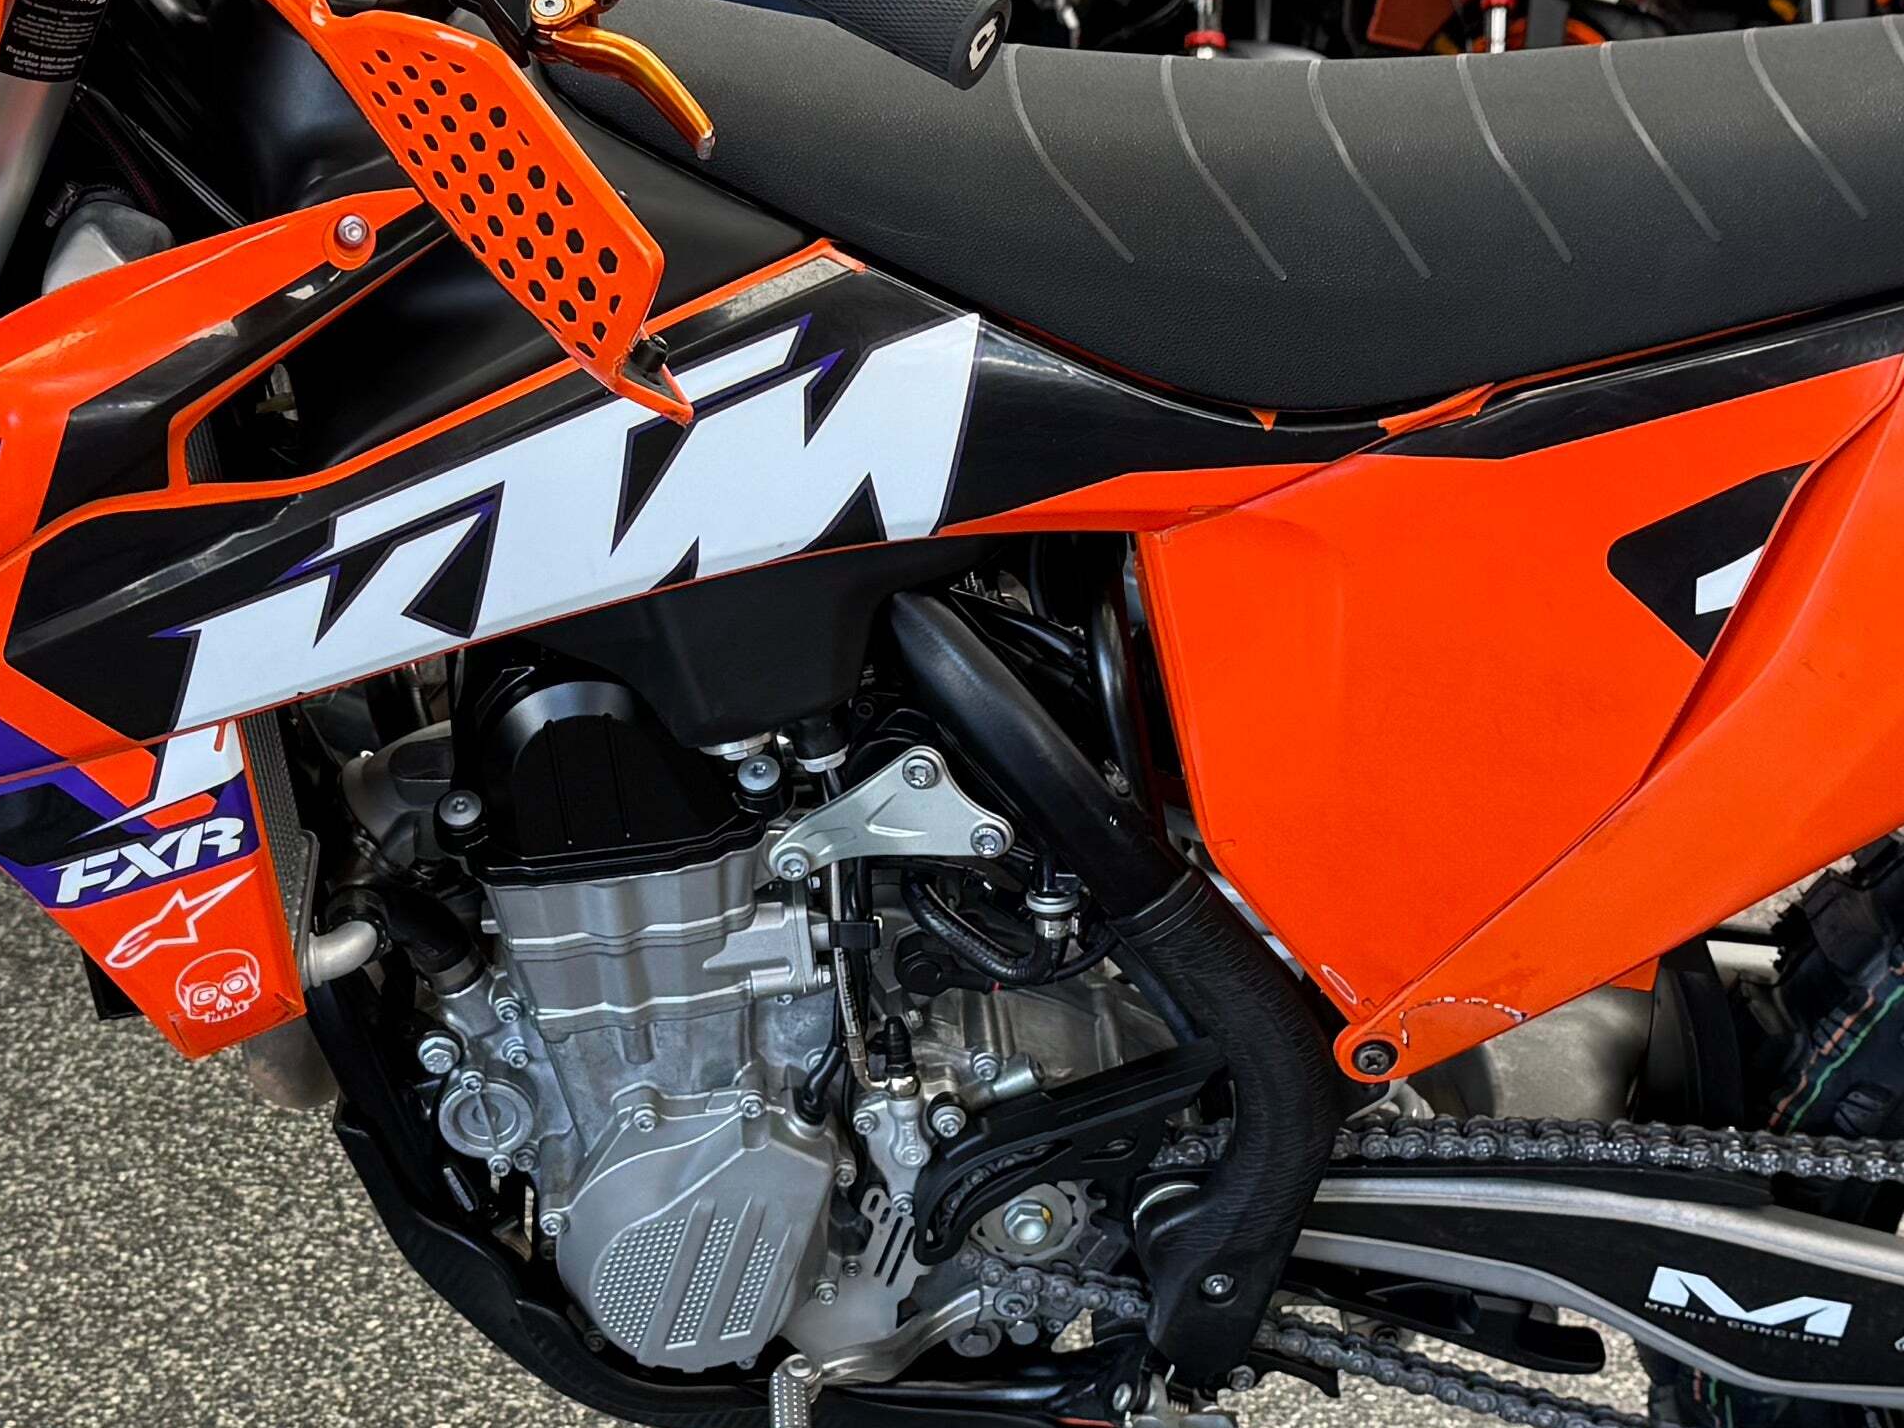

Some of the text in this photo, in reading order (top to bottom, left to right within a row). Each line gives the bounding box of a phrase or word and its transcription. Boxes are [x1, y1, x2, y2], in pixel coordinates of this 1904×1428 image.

[66, 312, 980, 844] KTM
[48, 816, 245, 904] FXR
[1644, 1301, 1840, 1347] MATRIX CONCEPTS
